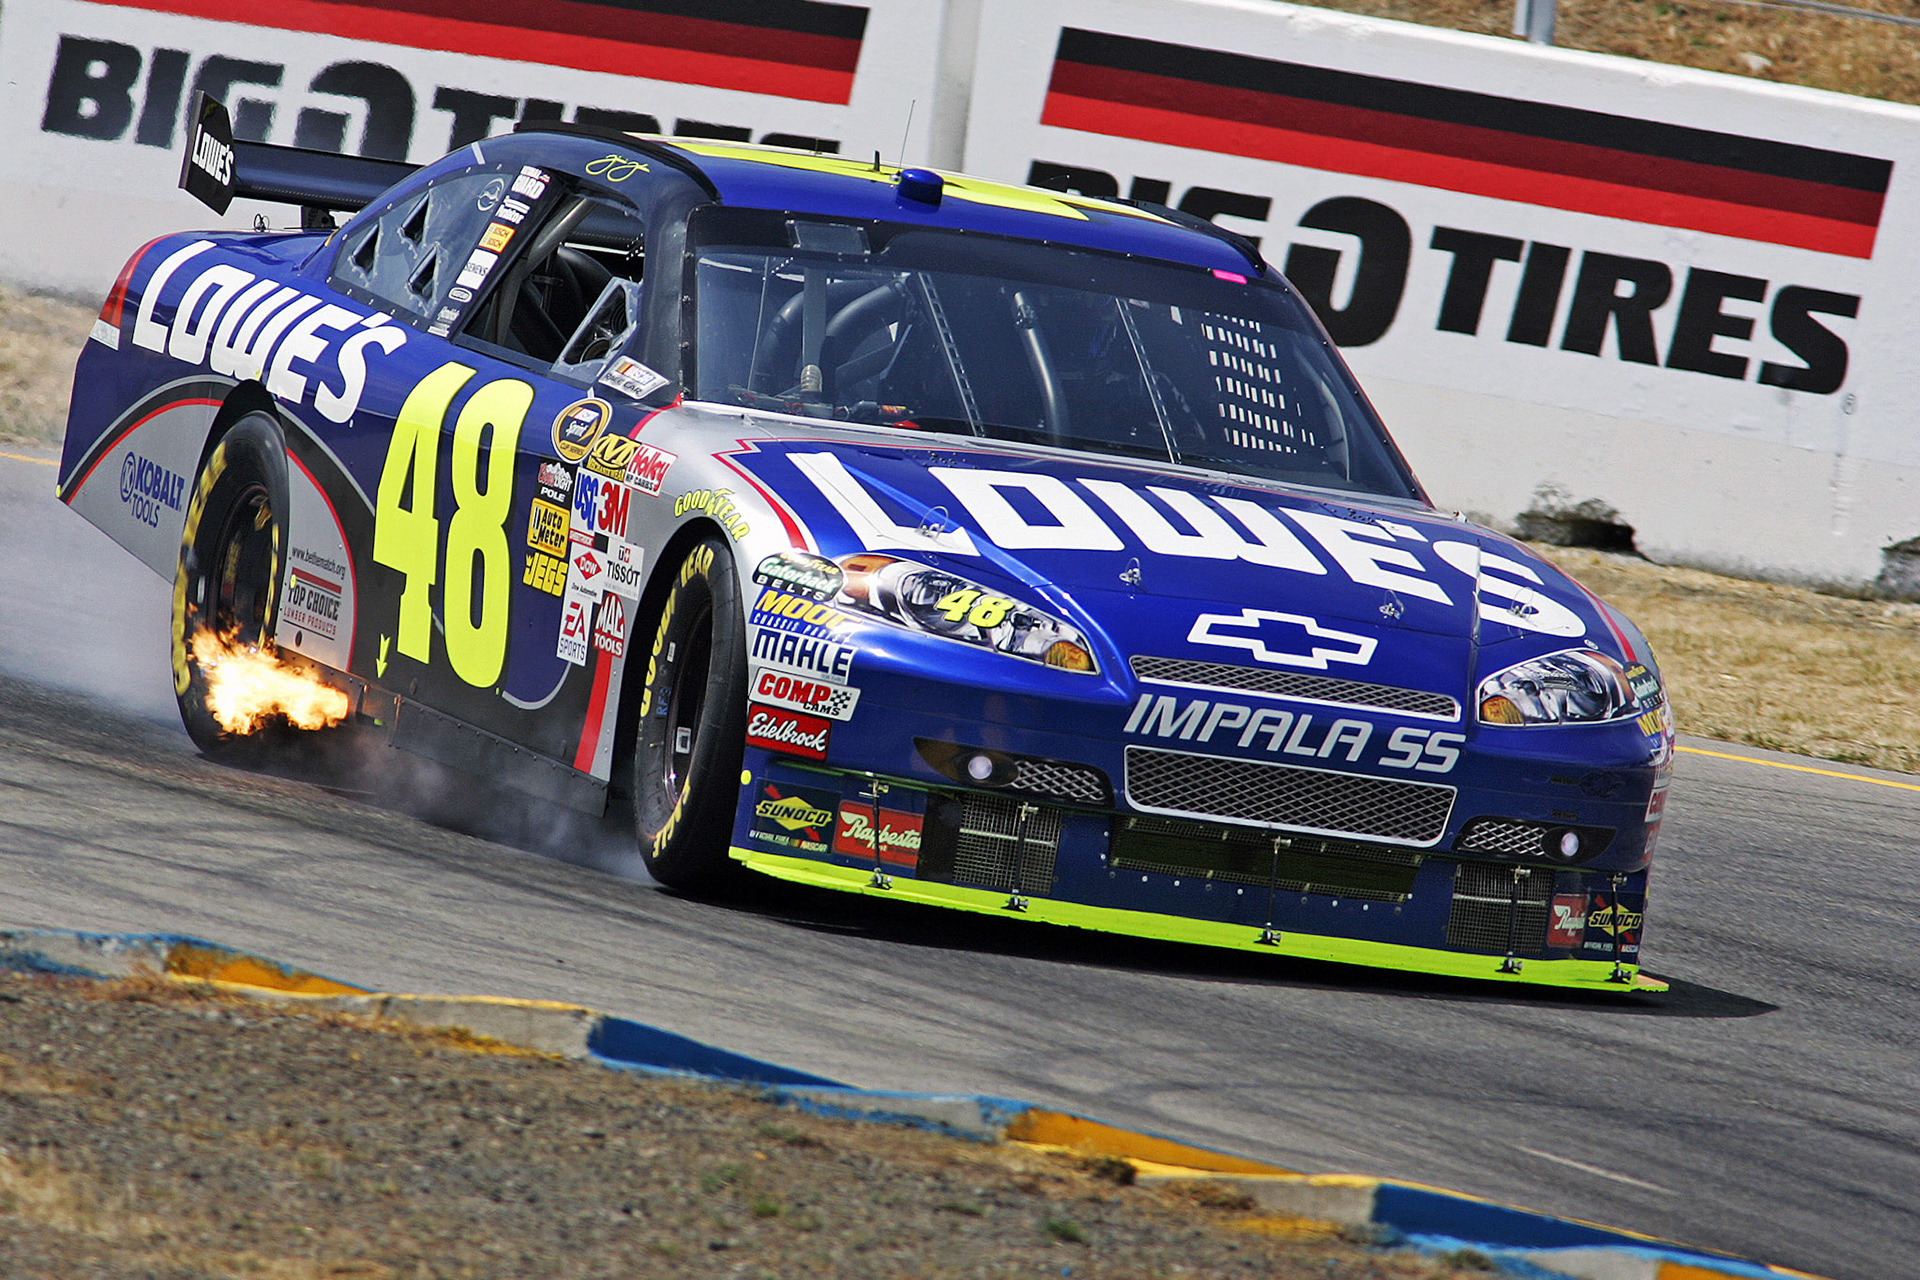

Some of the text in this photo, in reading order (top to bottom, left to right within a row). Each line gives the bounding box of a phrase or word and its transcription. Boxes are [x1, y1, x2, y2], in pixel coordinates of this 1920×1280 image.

[192, 124, 234, 186] LOWE'S
[1429, 225, 1862, 395] TIRES
[132, 240, 407, 425] LOWE'S
[604, 373, 642, 395] RACE CAR
[566, 420, 589, 437] Sprint
[560, 443, 569, 451] CUP
[135, 456, 185, 511] KOBALT
[626, 473, 654, 491] HP CARBS
[628, 446, 670, 491] Holley
[132, 493, 160, 528] TOOLS
[540, 486, 565, 502] POLE
[574, 472, 630, 537] USG 3M
[373, 361, 534, 688] 48
[542, 508, 562, 529] Auto
[540, 525, 565, 548] Meter
[785, 452, 1587, 637] LOWE'S
[522, 552, 568, 597] JEGS
[756, 574, 826, 601] BELTS
[758, 557, 839, 594] Gatorback
[284, 606, 306, 622] LUMBER
[306, 590, 340, 621] CHOICE
[563, 601, 585, 641] EA
[596, 594, 624, 639] MAC
[753, 612, 799, 632] CHASSIS
[934, 589, 1014, 628] 48
[559, 638, 586, 661] SPORTS
[594, 633, 623, 656] TOOLS
[752, 628, 853, 677] MAHLE
[758, 673, 832, 705] COMP
[802, 701, 840, 716] CAMS
[747, 712, 829, 752] Edelbrock
[1123, 693, 1466, 773] IMPALA SS
[760, 801, 829, 825] SUNOCO
[840, 811, 922, 849] Raybesto
[801, 840, 828, 852] NASCAR
